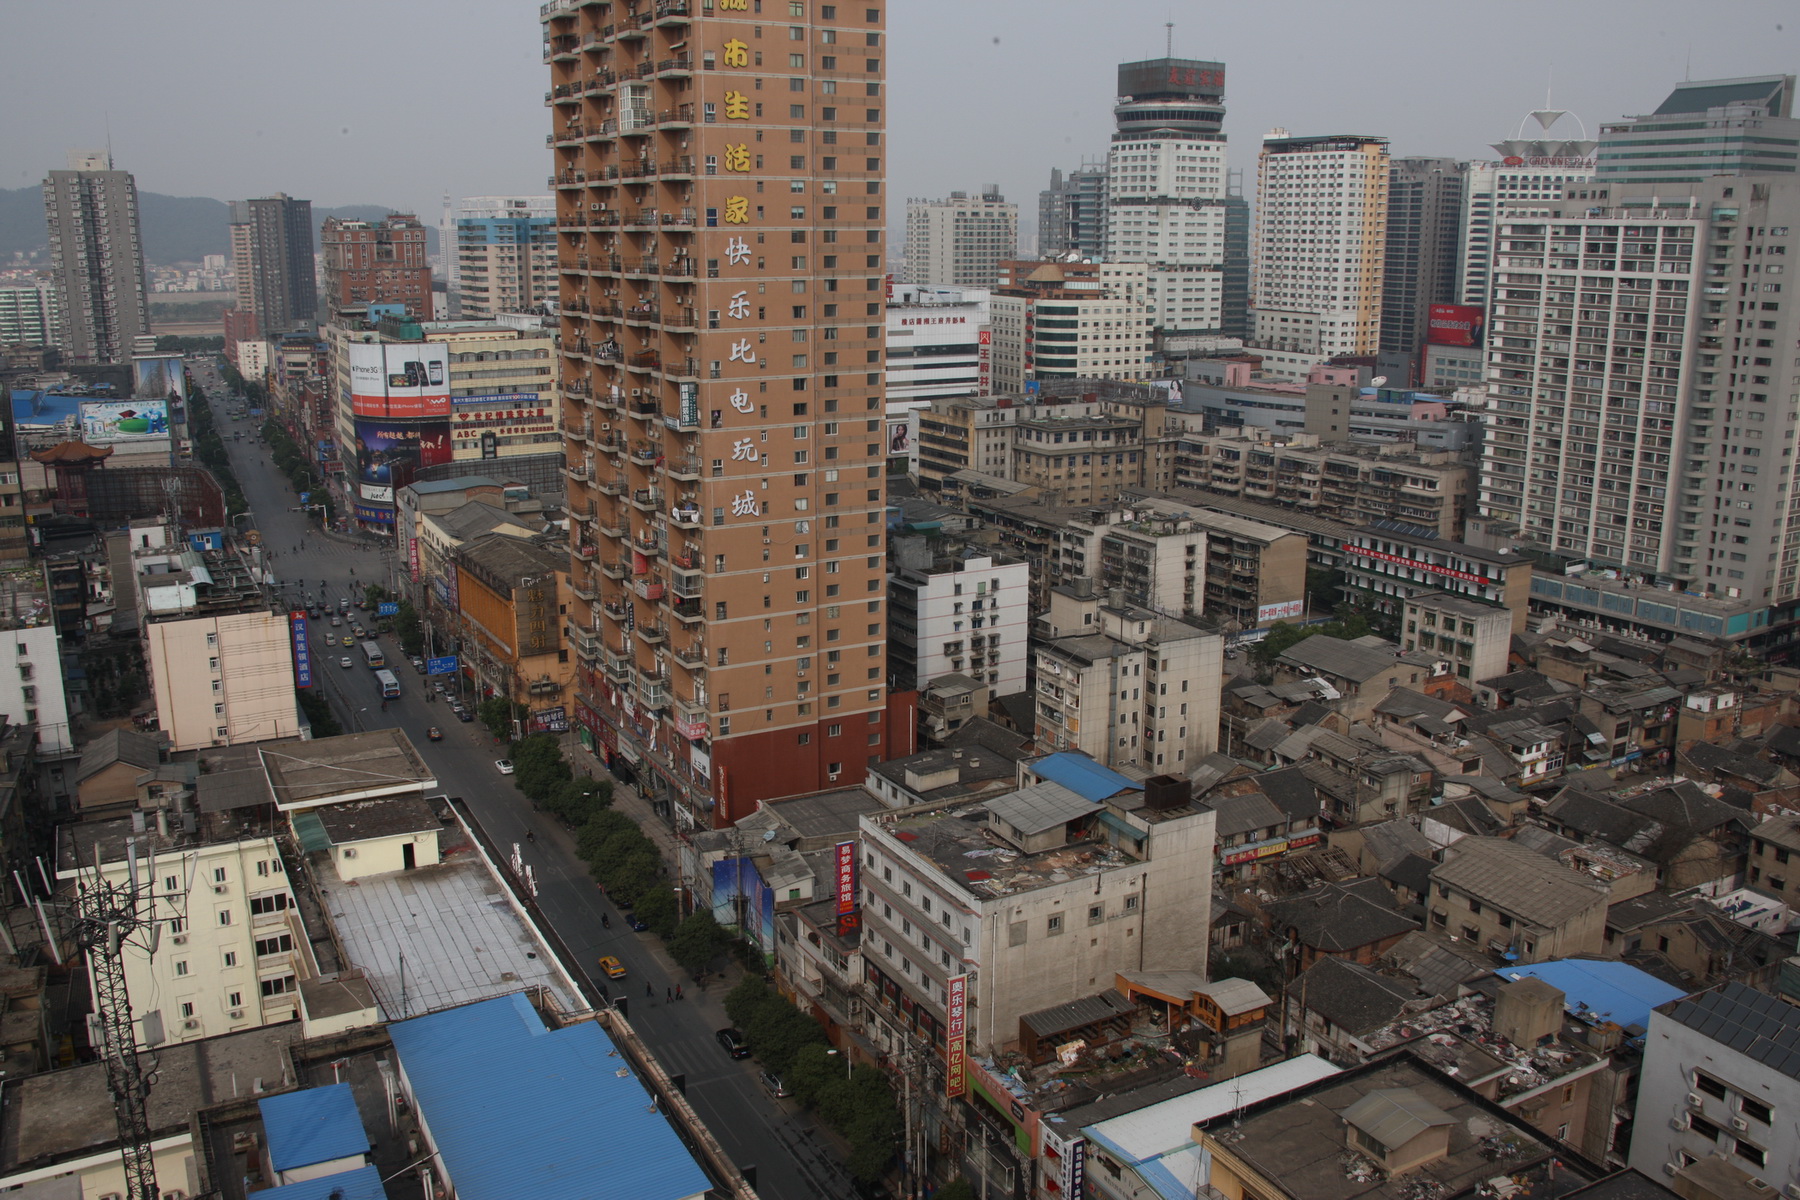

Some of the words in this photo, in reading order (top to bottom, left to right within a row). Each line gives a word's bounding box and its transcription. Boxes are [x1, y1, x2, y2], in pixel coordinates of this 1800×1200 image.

[1529, 157, 1570, 165] CROWNE
[725, 236, 760, 517] 快乐比电玩城
[457, 430, 477, 438] ABC
[527, 589, 546, 649] 魅力四射
[295, 623, 309, 681] 汉庭连锁酒店
[840, 845, 852, 902] 易梦商务旅馆
[950, 981, 963, 1031] 奥乐琴行
[950, 1040, 962, 1088] 高亿网吧
